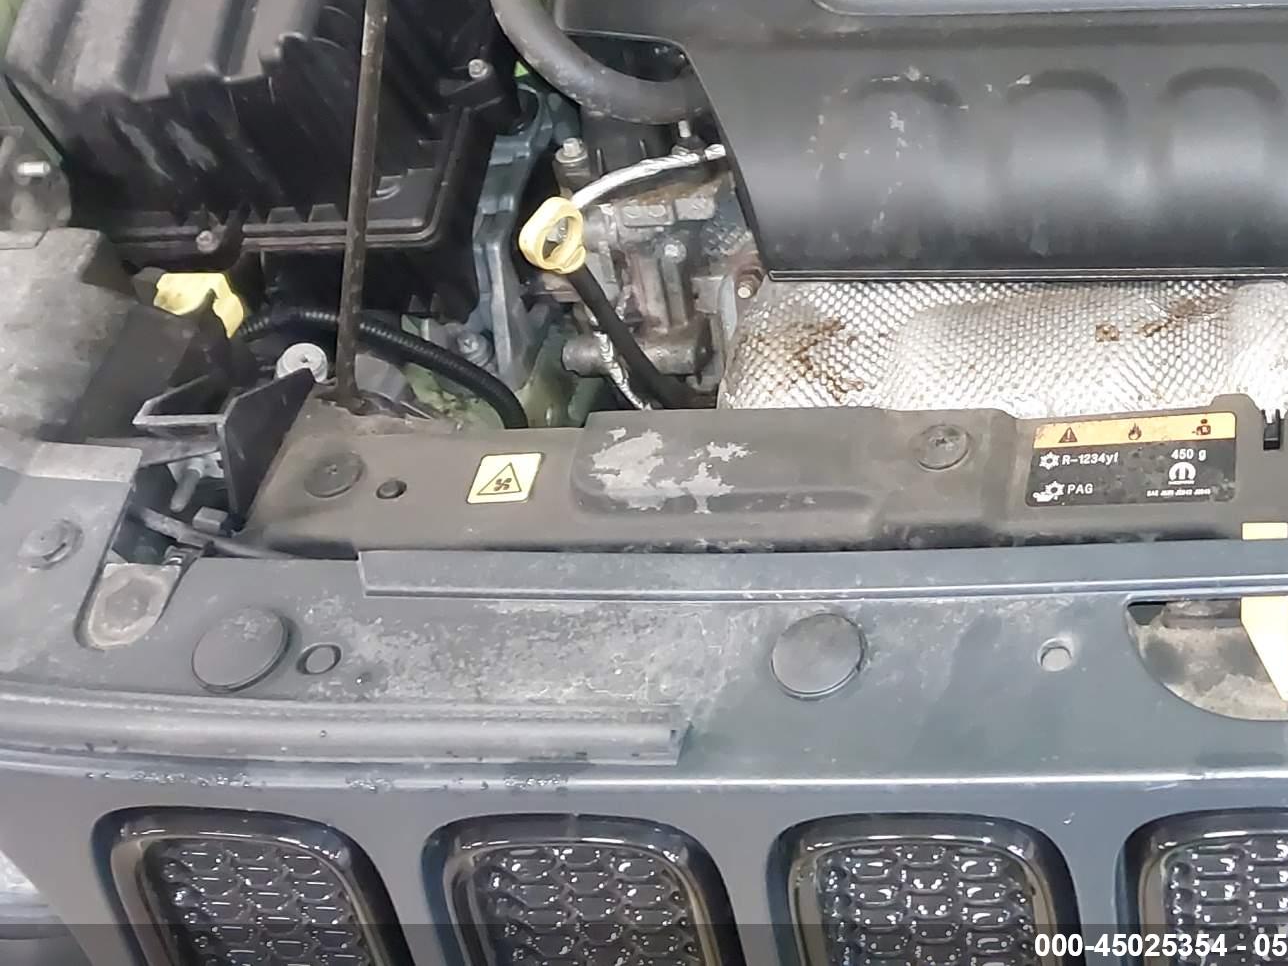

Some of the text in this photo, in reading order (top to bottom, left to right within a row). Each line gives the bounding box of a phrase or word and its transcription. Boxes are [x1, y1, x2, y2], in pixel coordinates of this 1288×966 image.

[1061, 452, 1119, 467] R-1234yf
[1171, 449, 1207, 461] 450 g
[1067, 484, 1094, 495] PAG
